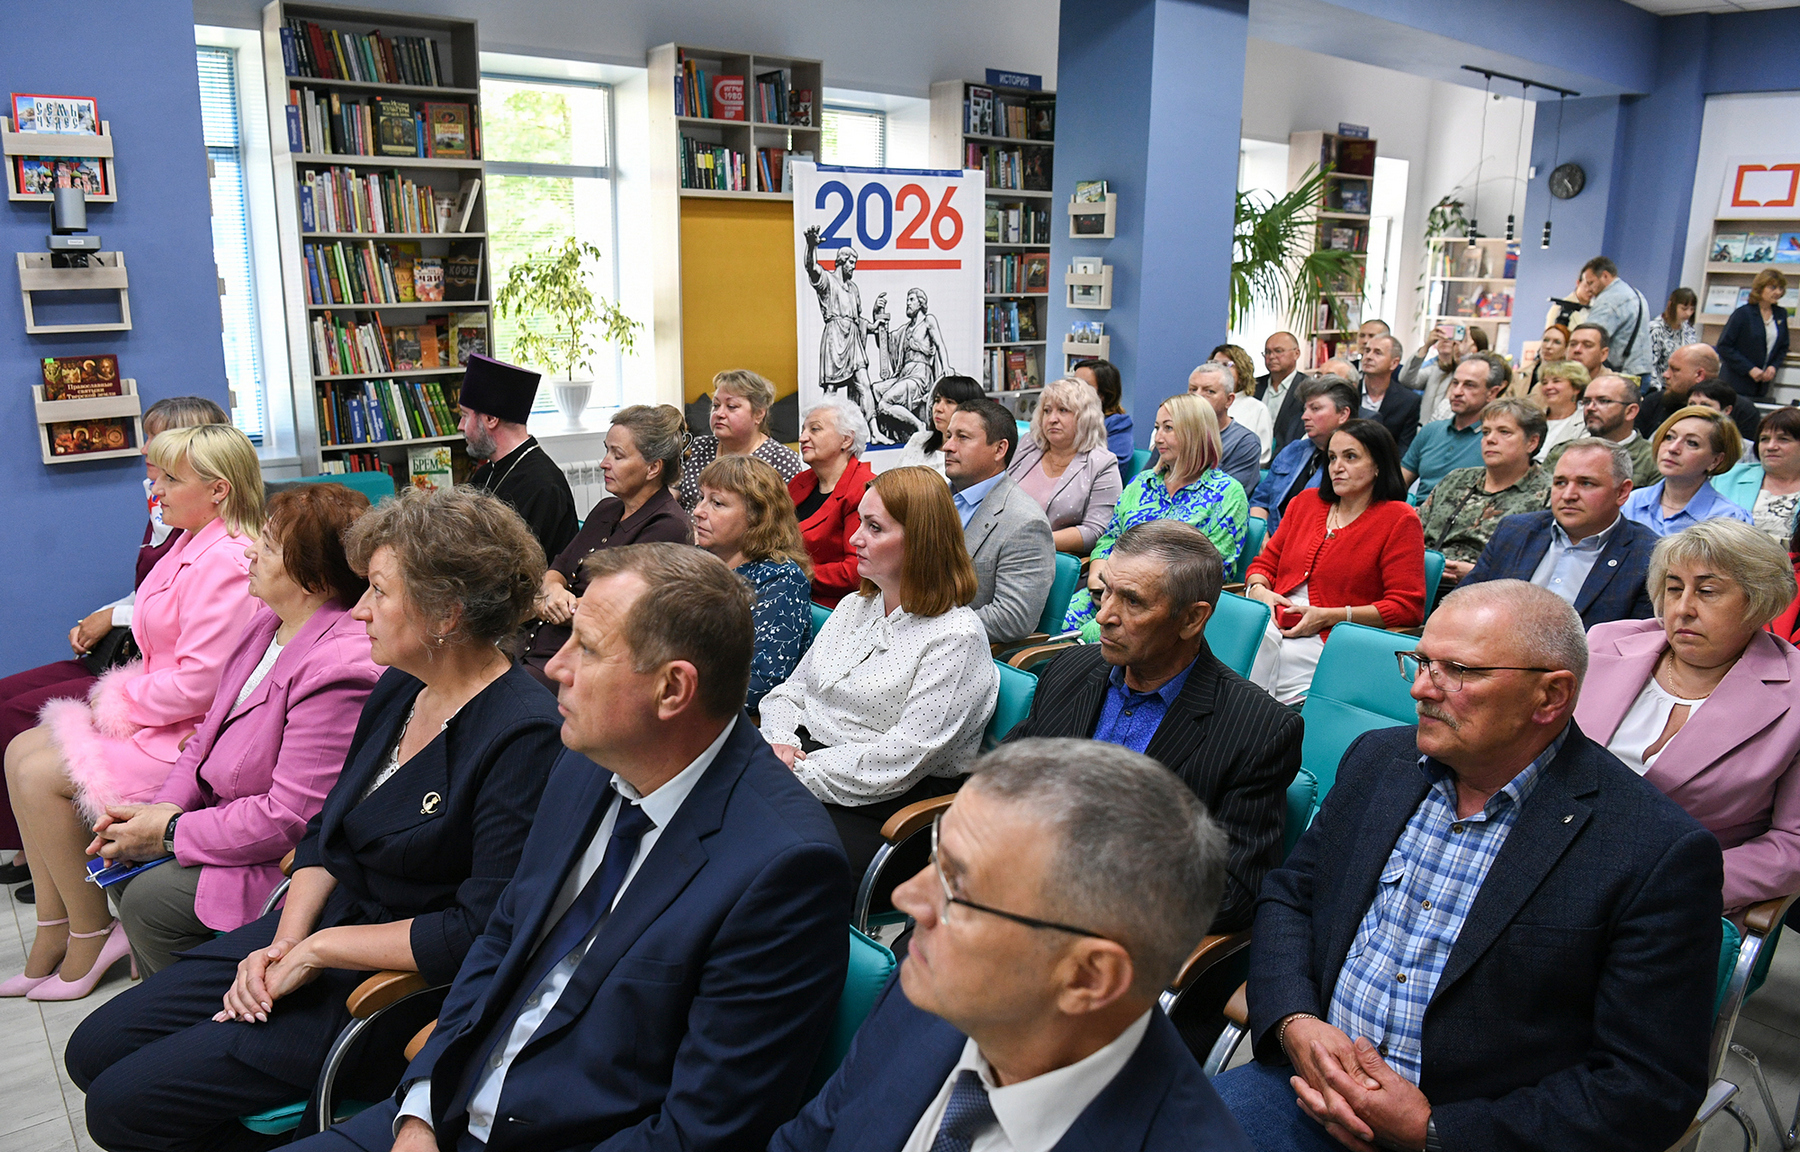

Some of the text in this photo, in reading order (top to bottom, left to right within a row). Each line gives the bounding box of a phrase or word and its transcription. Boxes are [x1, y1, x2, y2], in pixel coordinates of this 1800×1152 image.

[999, 74, 1029, 86] ИСТОРИЯ
[815, 180, 964, 251] 2026
[449, 265, 475, 276] КОФЕ
[412, 458, 439, 471] БРЕМ
